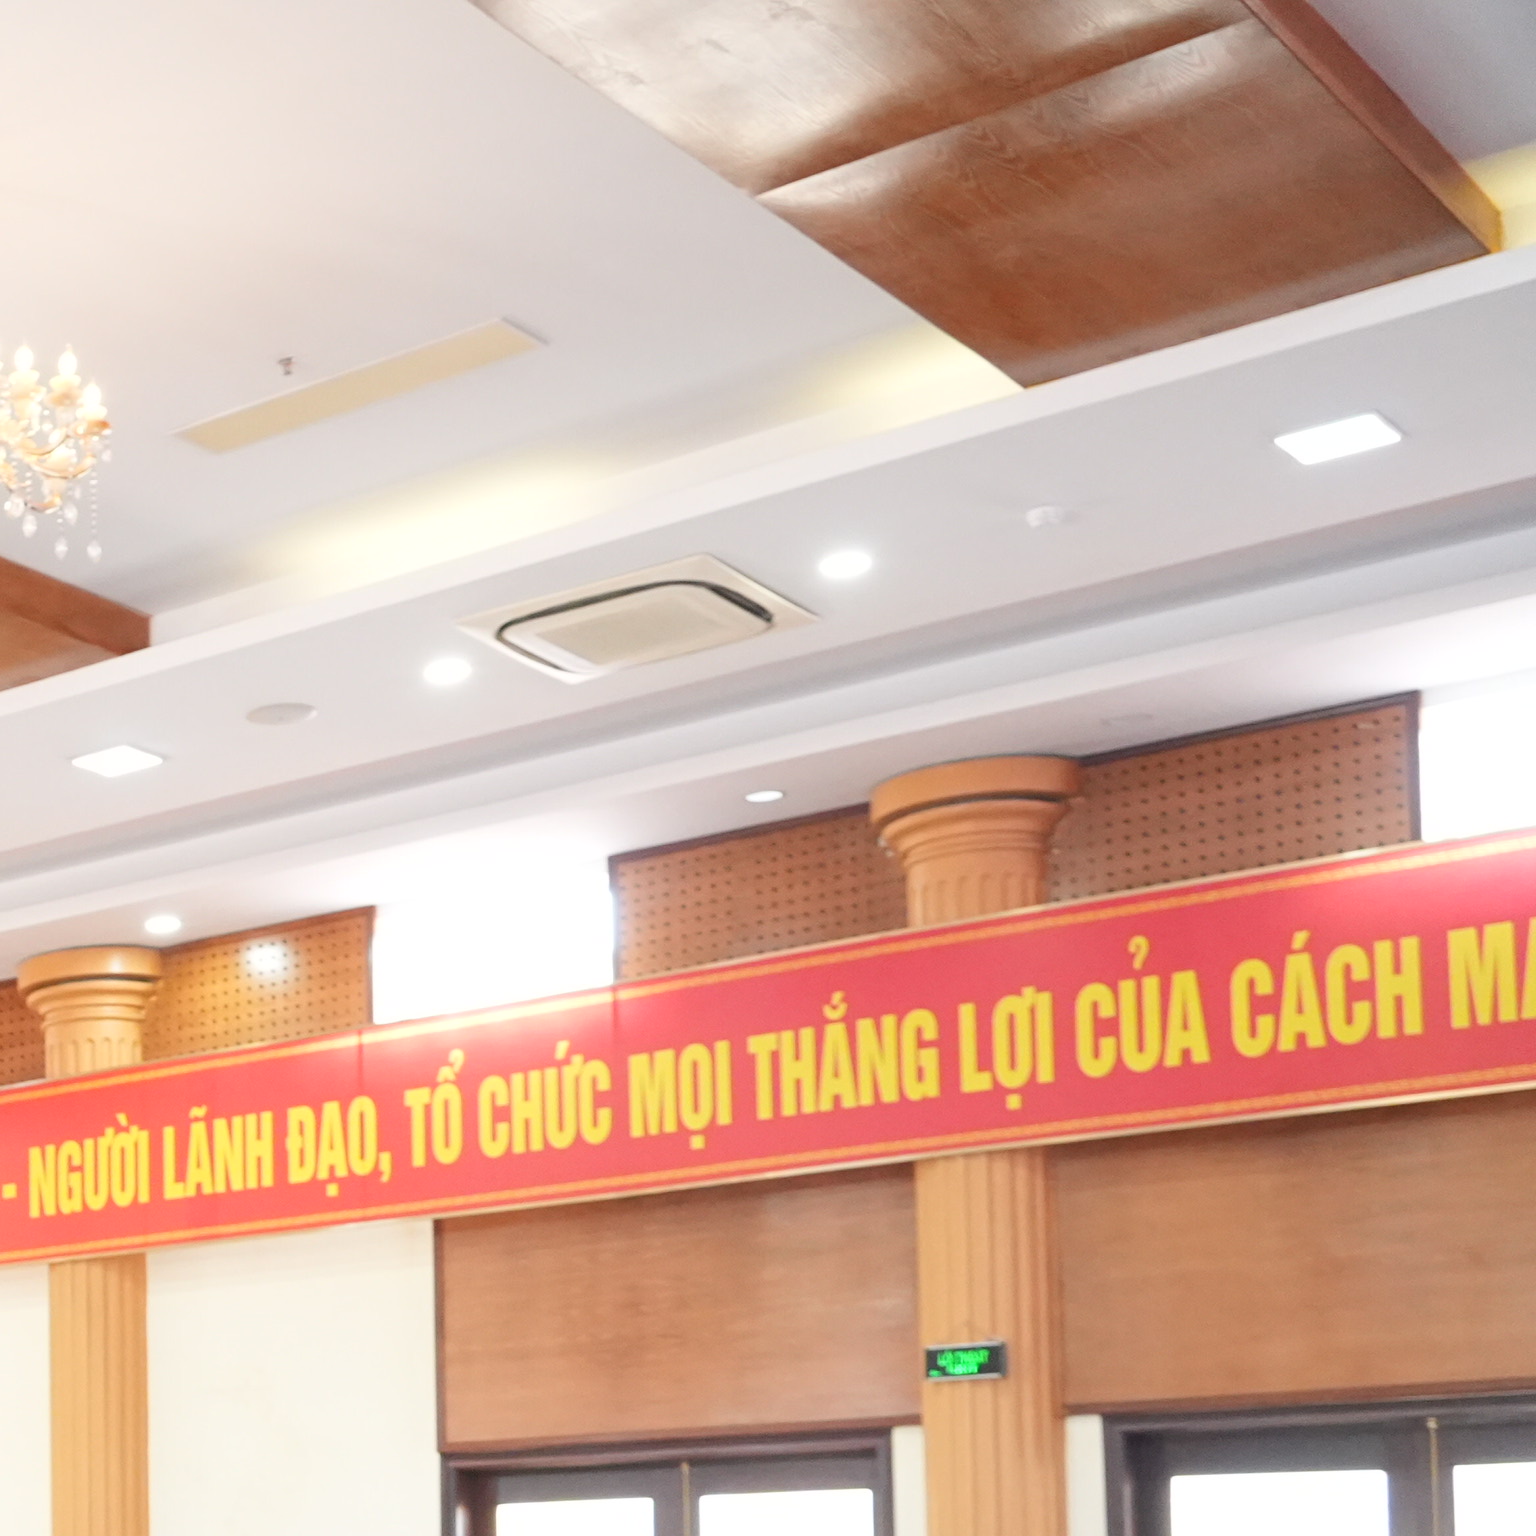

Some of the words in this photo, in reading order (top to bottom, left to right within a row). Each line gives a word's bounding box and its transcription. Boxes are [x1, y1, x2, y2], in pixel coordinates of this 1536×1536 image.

[28, 1113, 150, 1219] NGƯỜI
[163, 1106, 274, 1201] LÃNH
[286, 1096, 392, 1198] ĐẠO,
[404, 1048, 465, 1168] TỔ
[477, 1039, 612, 1160] CHỨC
[628, 1039, 733, 1150] MỌI
[747, 990, 940, 1121] THẮNG
[958, 985, 1055, 1110] LỢI
[1075, 935, 1211, 1079] CỦA
[1230, 930, 1423, 1058] CÁCH
